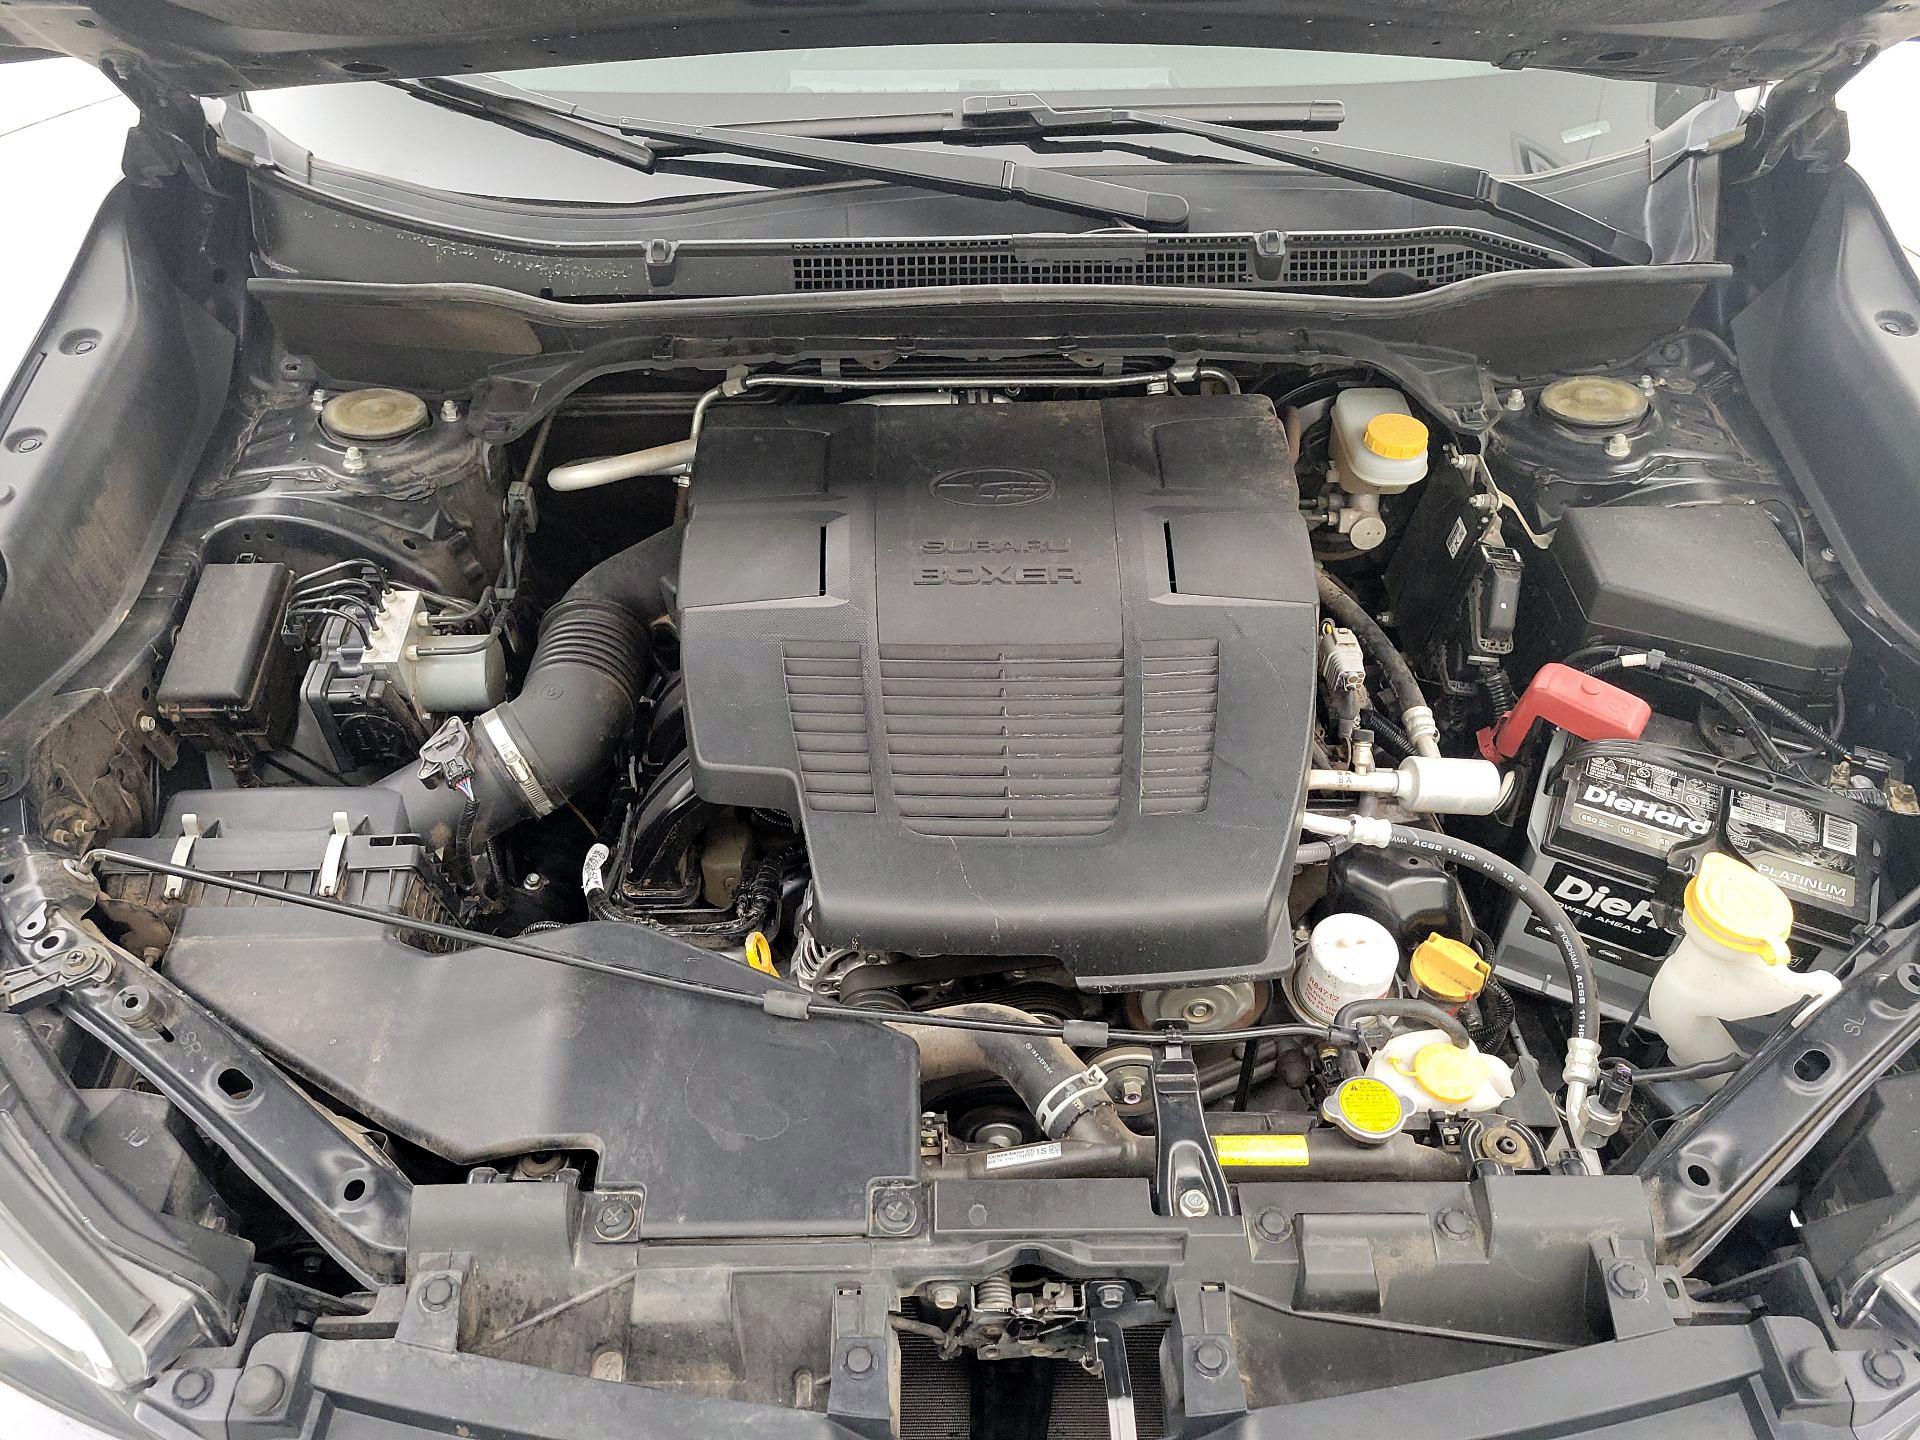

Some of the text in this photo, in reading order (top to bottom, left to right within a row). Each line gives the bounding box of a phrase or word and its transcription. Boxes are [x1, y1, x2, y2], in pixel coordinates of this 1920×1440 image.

[920, 537, 1071, 554] SUBARU
[912, 565, 1082, 585] BOXER
[1583, 784, 1713, 835] DieHard
[1461, 852, 1476, 861] HP
[1758, 863, 1847, 897] PLATINUM
[1554, 875, 1659, 929] DieH
[1557, 901, 1642, 934] OWER AHEAD
[1560, 931, 1580, 970] YOKOHAMA
[1577, 1024, 1586, 1039] HP
[1843, 1016, 1867, 1036] SL
